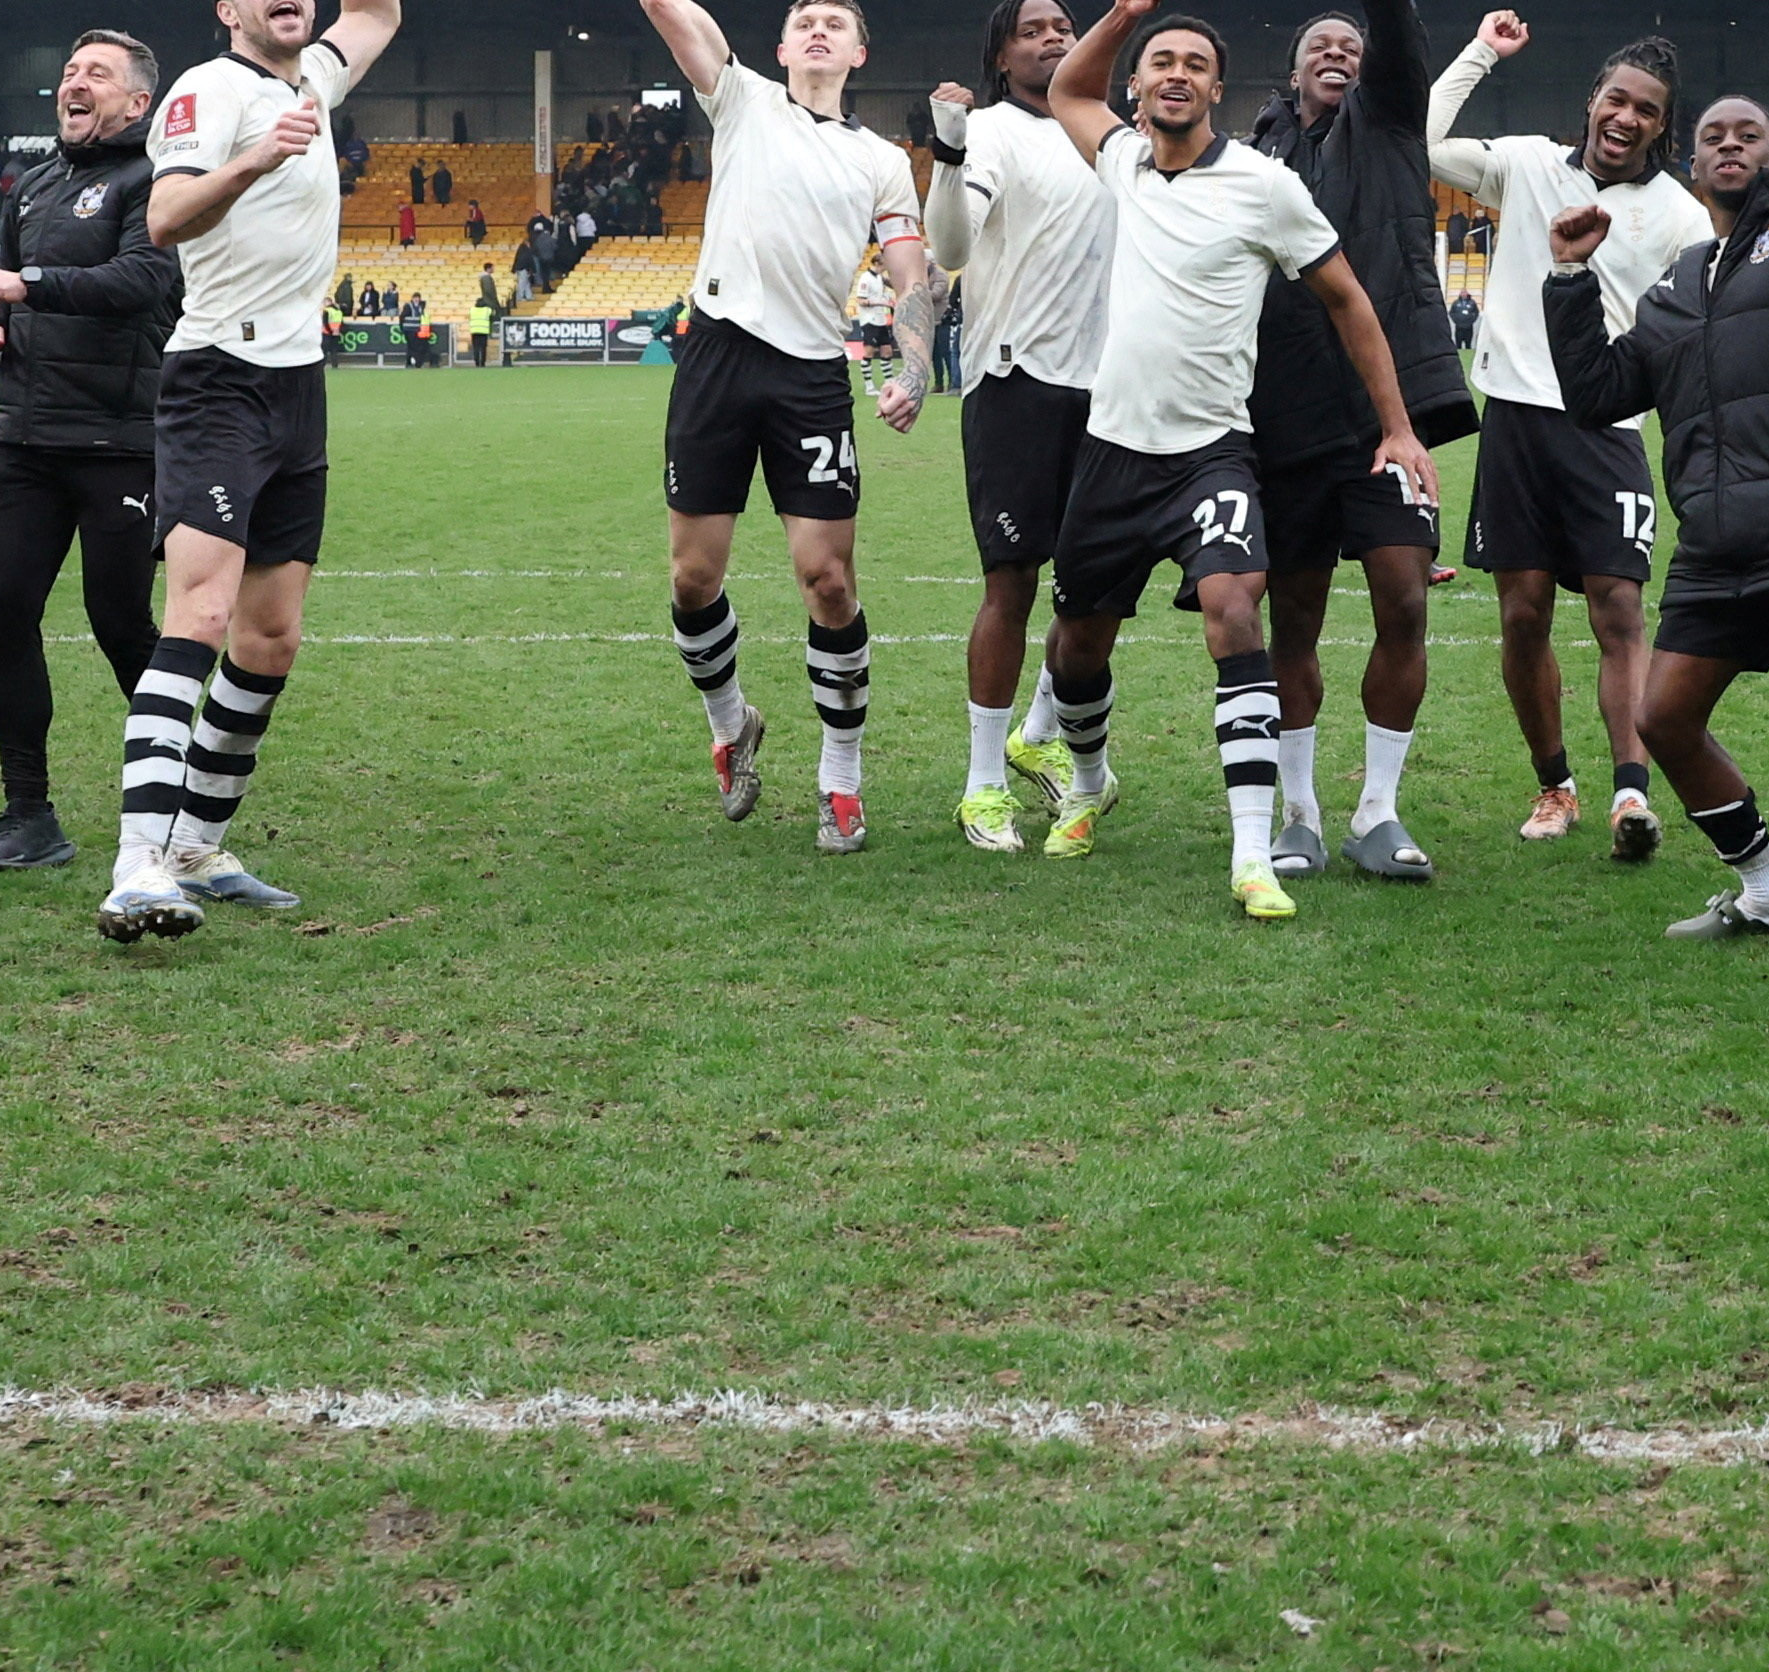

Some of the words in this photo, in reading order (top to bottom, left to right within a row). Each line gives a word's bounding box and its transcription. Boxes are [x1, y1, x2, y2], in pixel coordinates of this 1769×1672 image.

[529, 323, 602, 338] FOODHUB
[800, 430, 857, 483] 24
[1192, 489, 1249, 546] 27
[1615, 491, 1656, 543] 12
